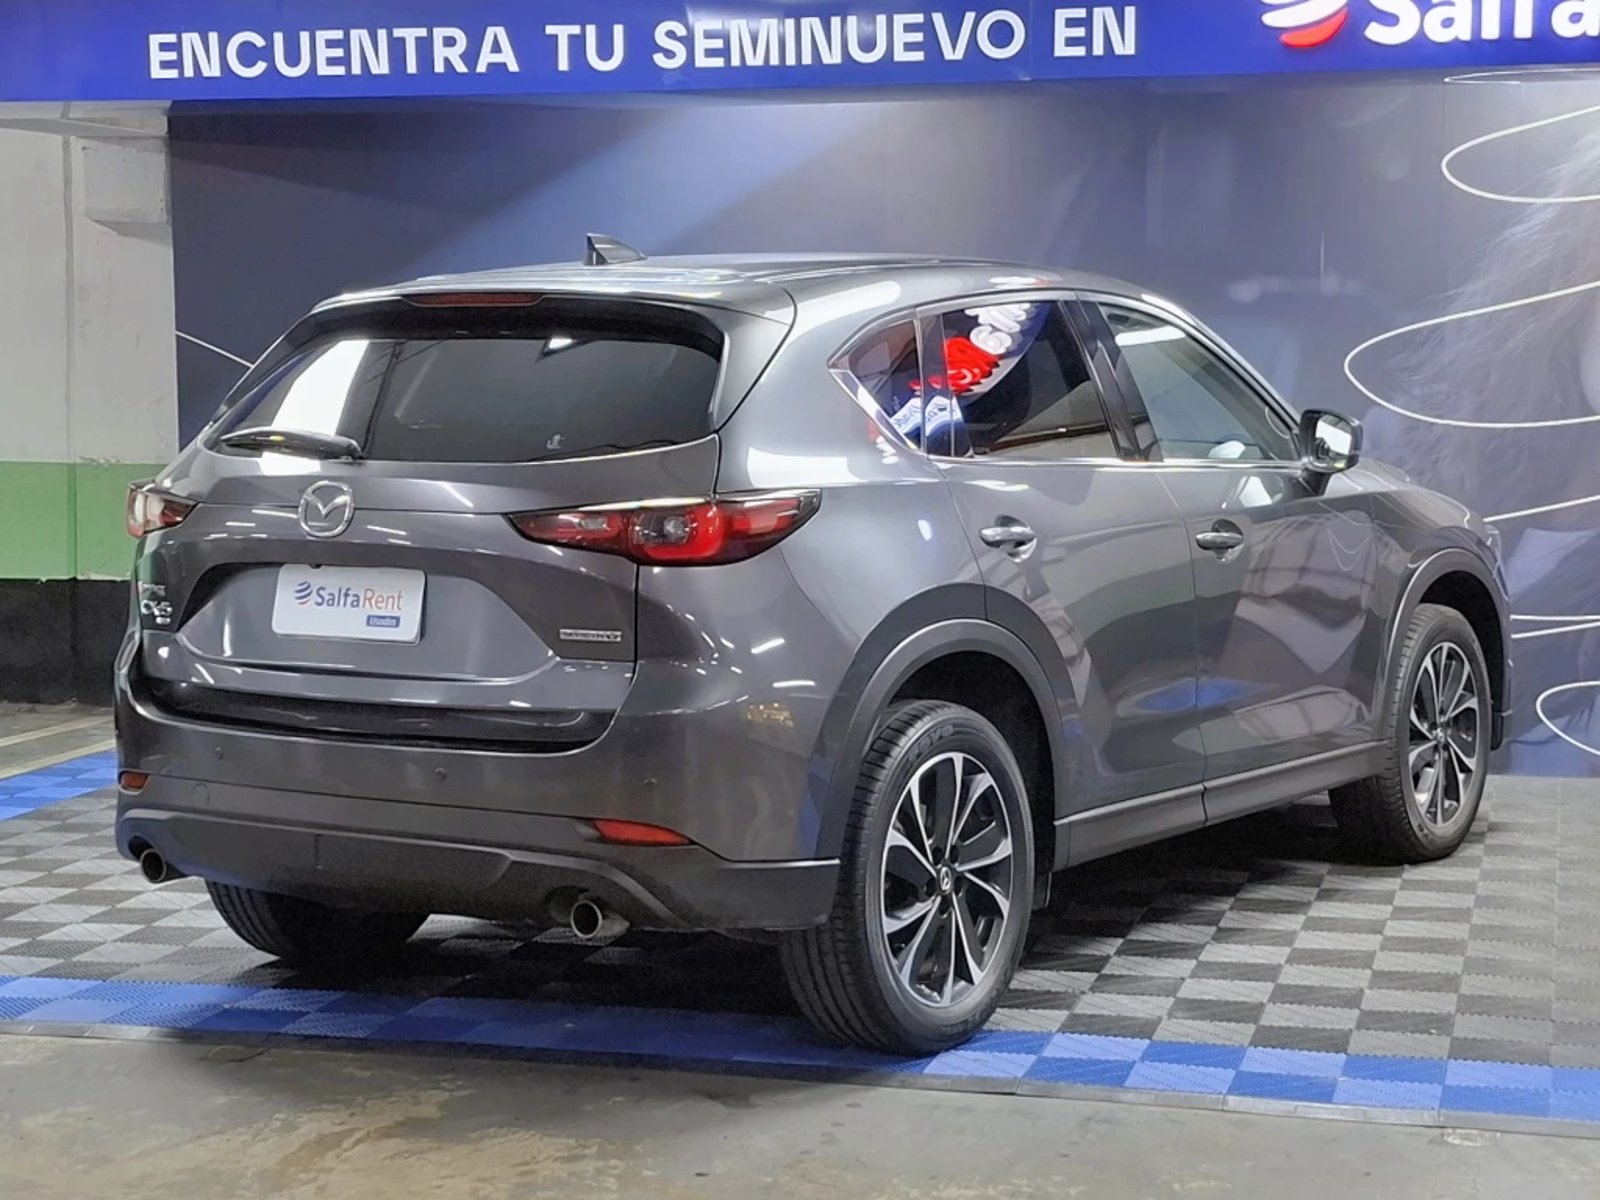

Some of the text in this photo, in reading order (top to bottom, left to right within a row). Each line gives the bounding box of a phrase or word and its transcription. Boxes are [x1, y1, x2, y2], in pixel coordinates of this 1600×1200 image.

[148, 5, 1136, 79] ENCUENTRA TU SEMINUEVO EN
[315, 586, 404, 611] SalfaRent
